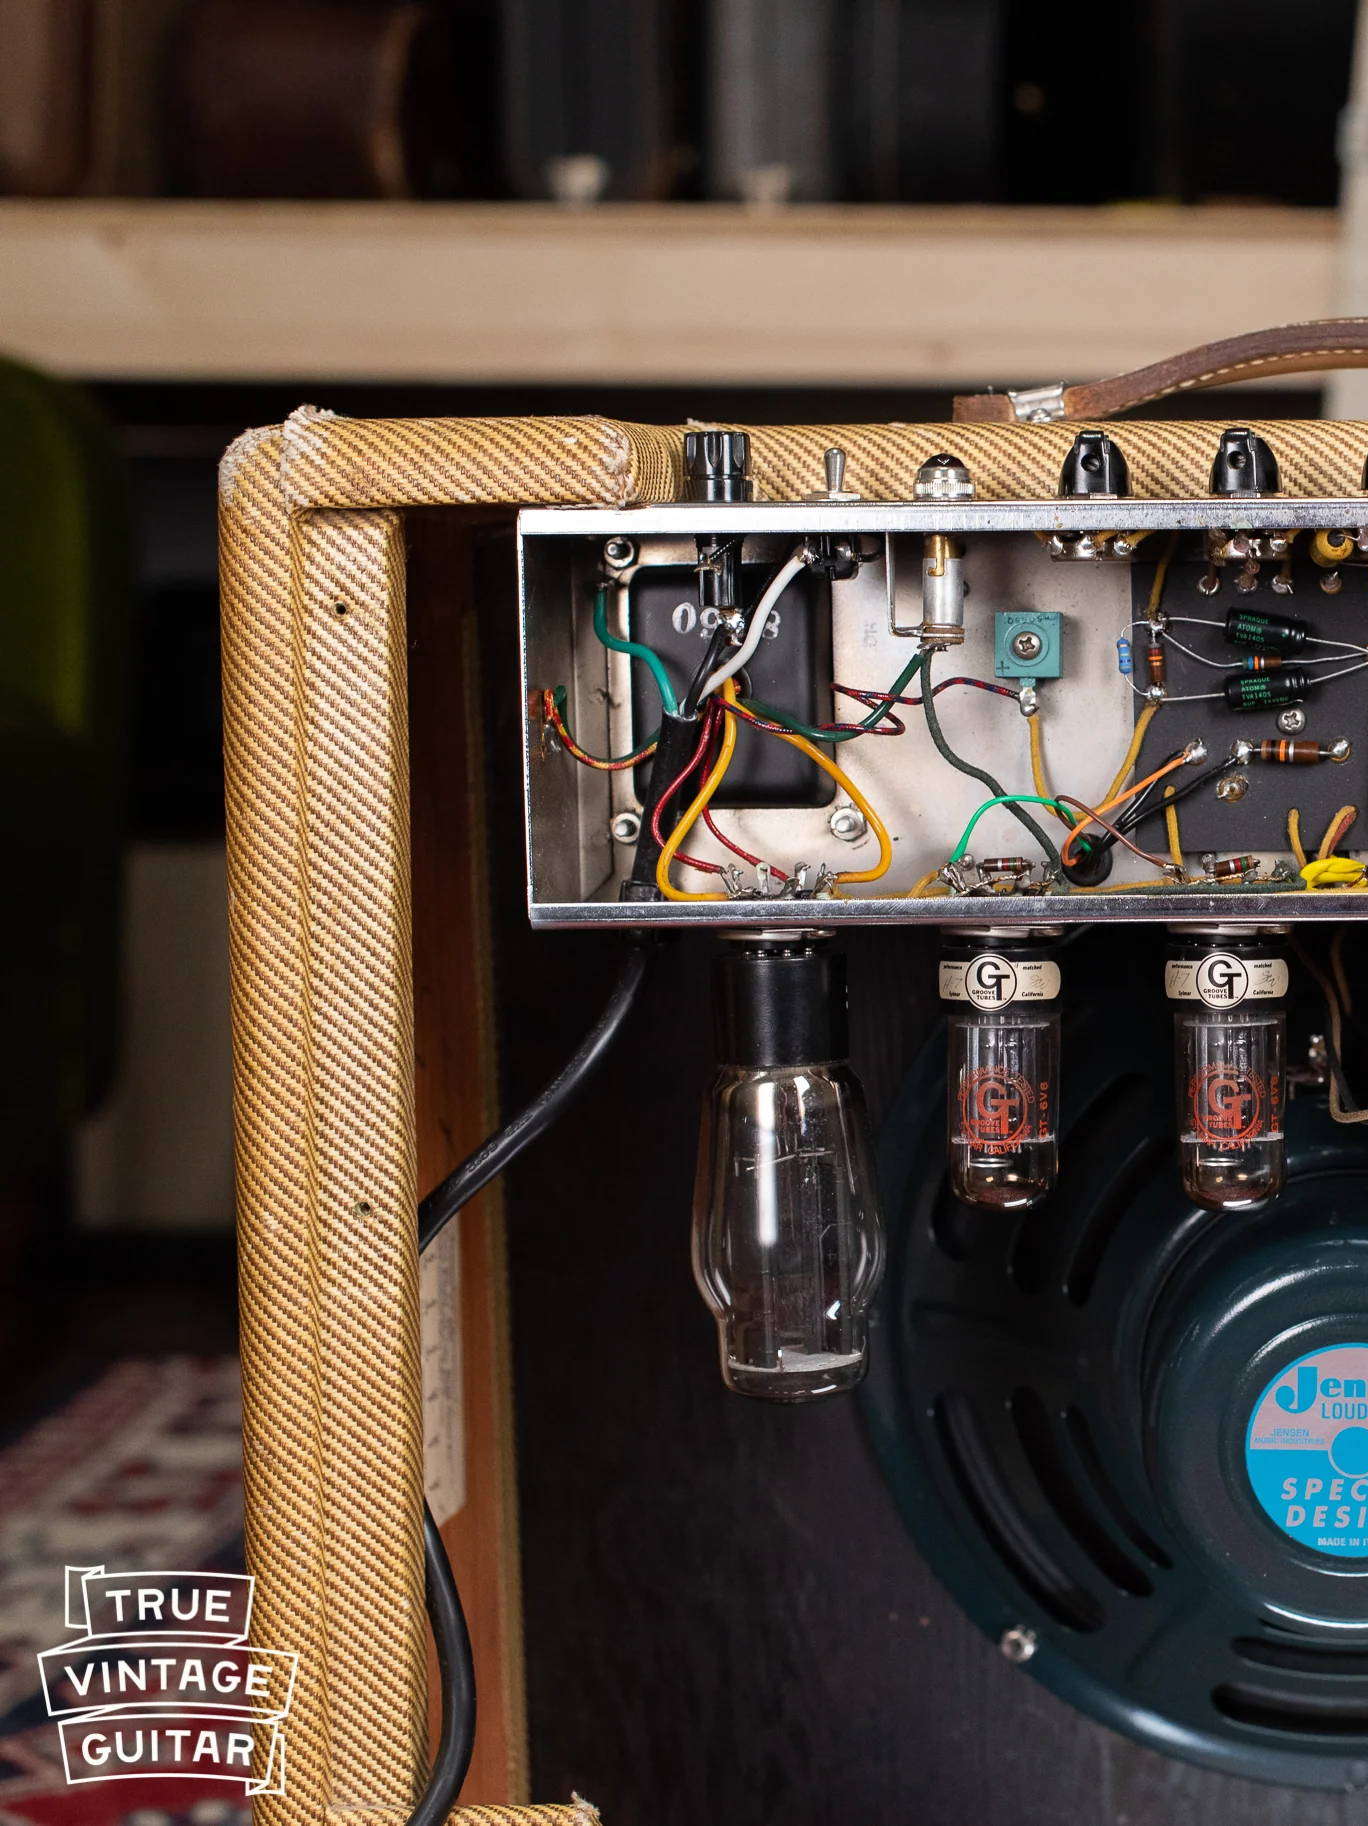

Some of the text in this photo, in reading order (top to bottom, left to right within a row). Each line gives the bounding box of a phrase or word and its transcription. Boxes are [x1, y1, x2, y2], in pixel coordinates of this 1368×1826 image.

[671, 602, 781, 640] 098
[1239, 614, 1269, 625] SPRAGUE
[1240, 677, 1270, 686] SPRAGUE
[976, 961, 1010, 1001] GT
[1208, 960, 1242, 999] GT
[1015, 1072, 1036, 1104] TESTED
[1247, 1067, 1267, 1099] TESTED
[976, 1081, 1019, 1135] GT
[1208, 1077, 1252, 1129] GT
[1208, 1121, 1233, 1129] TUBES
[1271, 1428, 1310, 1437] JENSEN
[1317, 1537, 1346, 1547] MADE
[1349, 1538, 1360, 1547] IN
